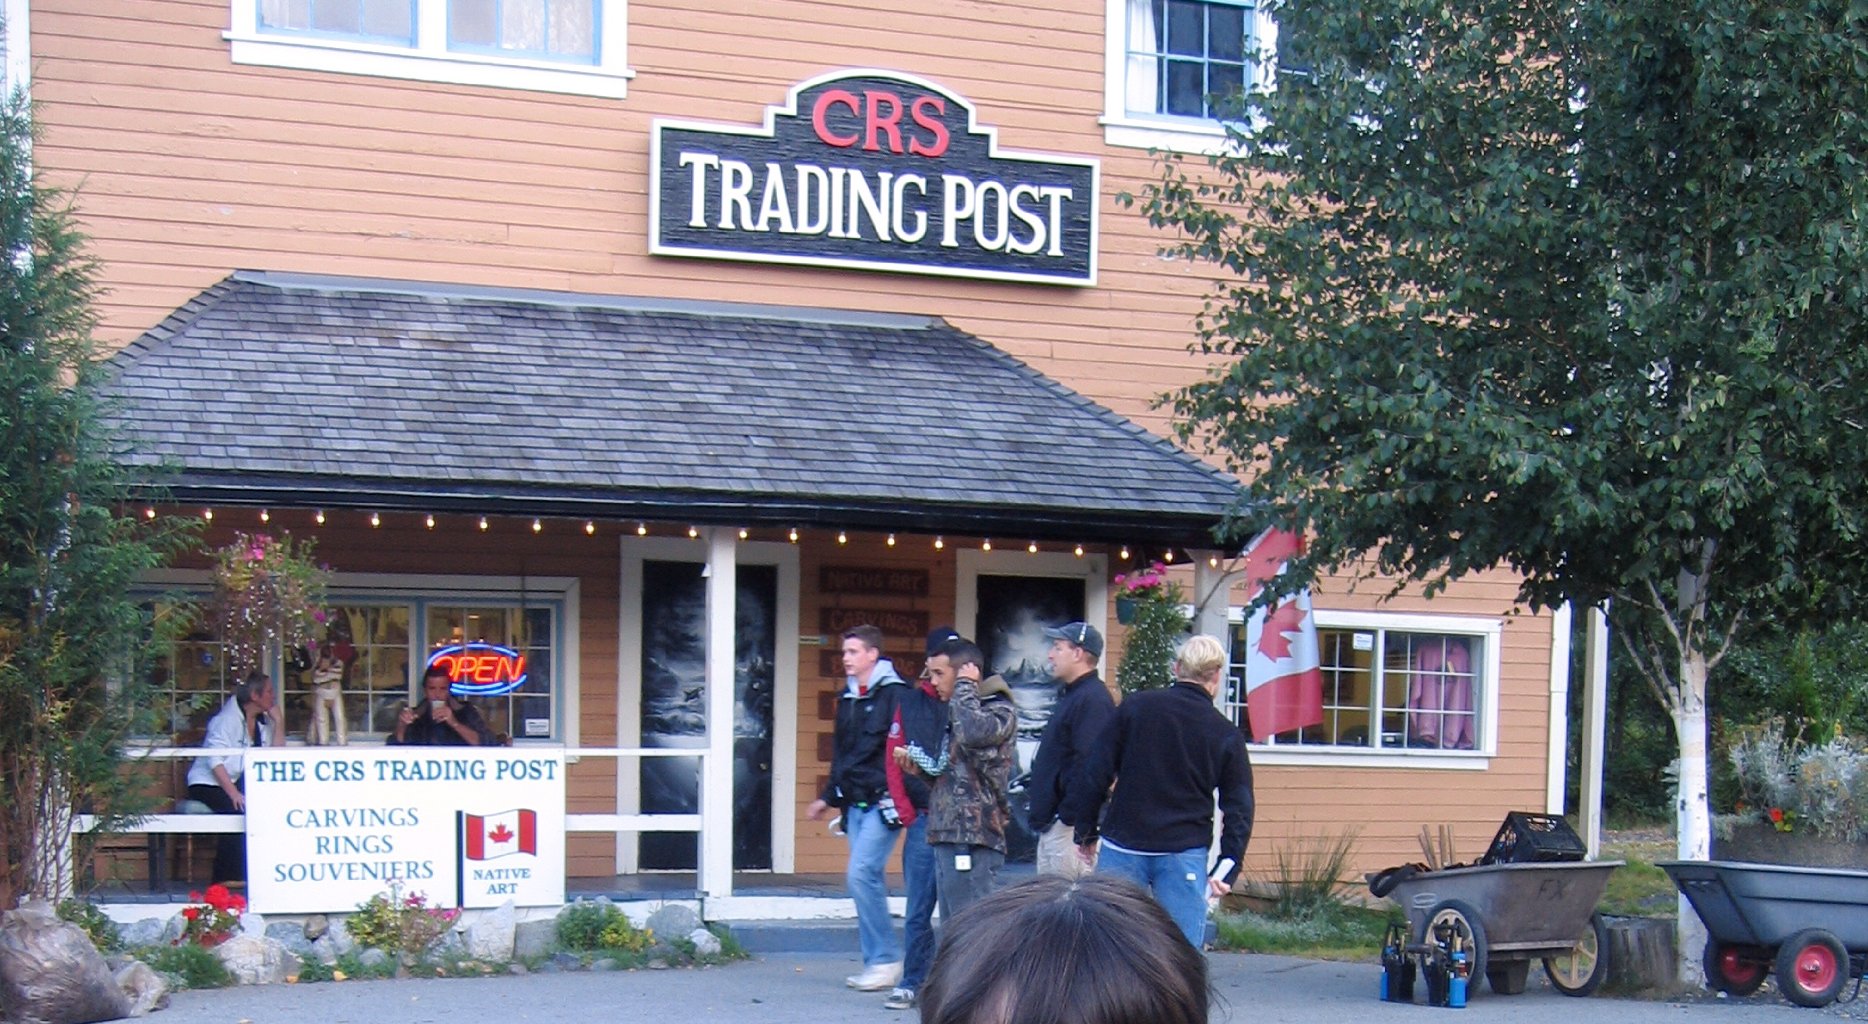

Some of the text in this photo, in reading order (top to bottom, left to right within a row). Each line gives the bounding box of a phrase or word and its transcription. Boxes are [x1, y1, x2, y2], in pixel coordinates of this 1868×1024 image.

[812, 89, 950, 157] CRS
[679, 152, 1073, 257] TRADING POST
[432, 655, 525, 683] OPEN
[252, 760, 558, 782] THE CRS TRADING POST
[286, 807, 419, 829] CARVINGS
[316, 835, 393, 855] RINGS
[275, 860, 434, 882] SOUVENIERS
[473, 868, 531, 881] NATIVE
[486, 882, 518, 895] ART
